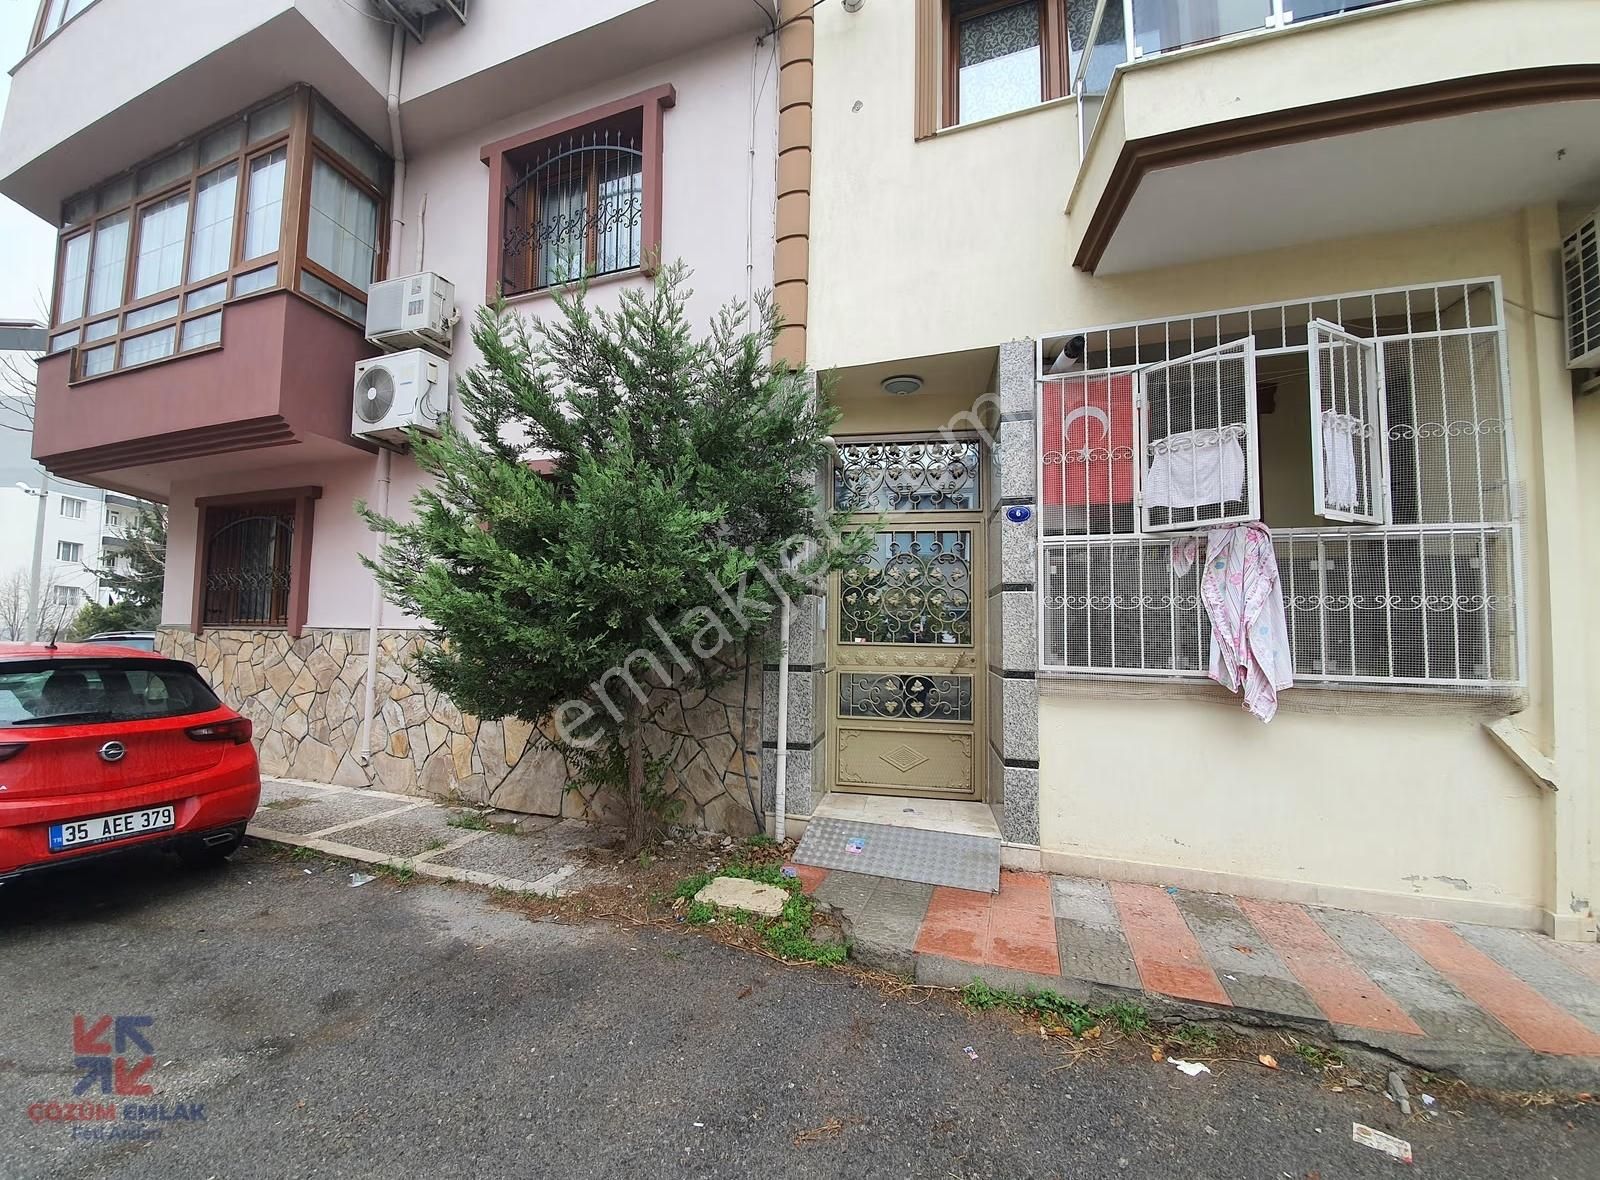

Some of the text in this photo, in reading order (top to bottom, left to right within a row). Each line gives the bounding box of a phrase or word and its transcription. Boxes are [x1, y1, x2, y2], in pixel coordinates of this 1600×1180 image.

[65, 823, 89, 843] 35
[102, 815, 134, 836] AEE
[141, 808, 171, 829] 379
